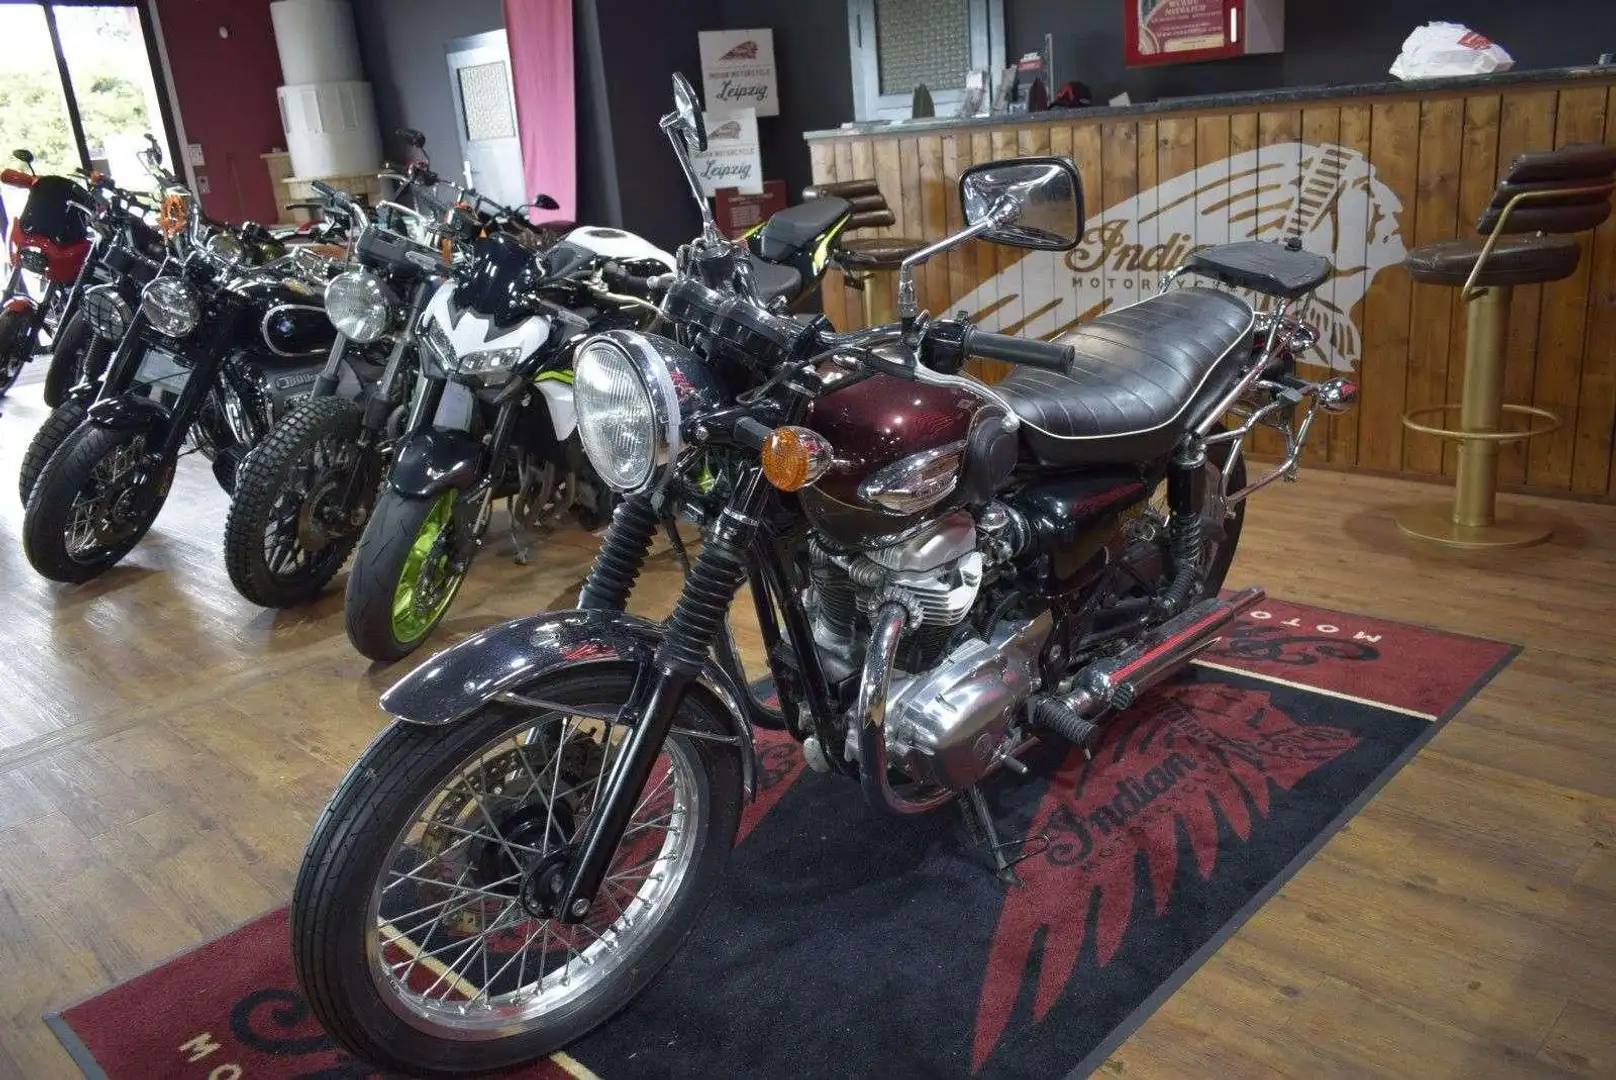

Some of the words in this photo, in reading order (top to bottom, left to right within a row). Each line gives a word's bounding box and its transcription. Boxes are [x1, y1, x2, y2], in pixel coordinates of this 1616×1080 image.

[716, 80, 768, 100] Leipzig
[701, 159, 752, 180] Leipzig
[1064, 218, 1216, 273] Indi
